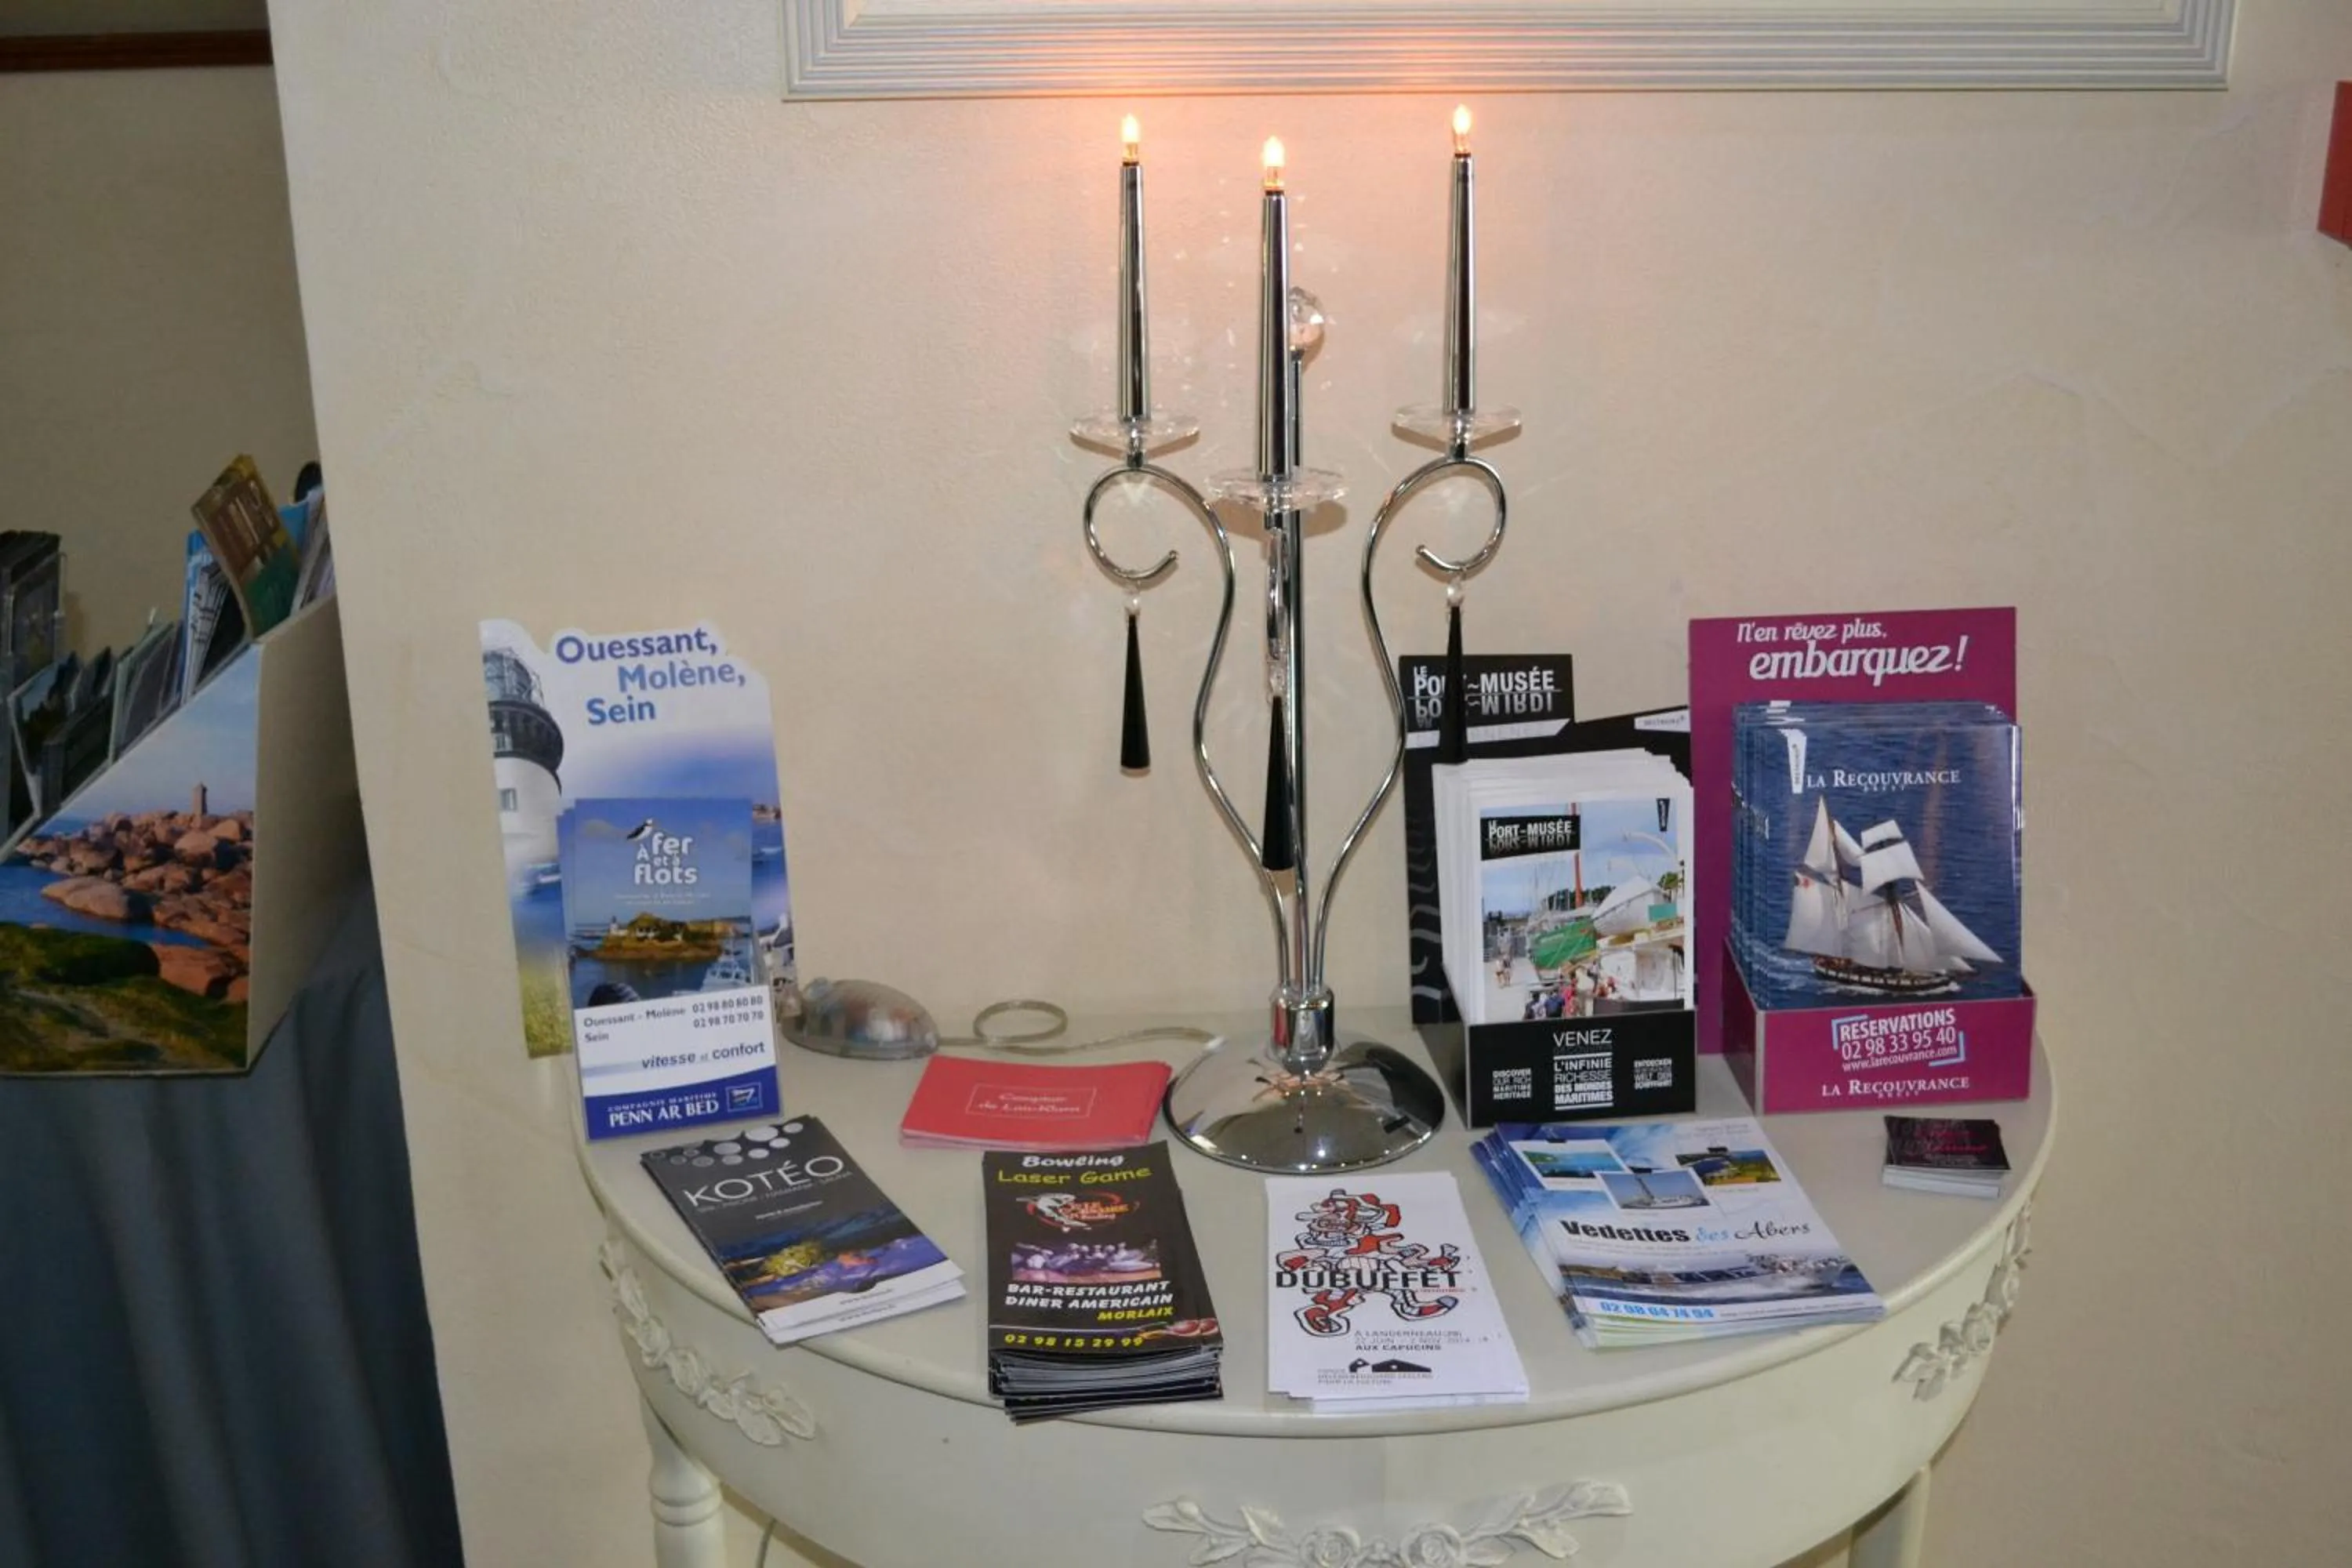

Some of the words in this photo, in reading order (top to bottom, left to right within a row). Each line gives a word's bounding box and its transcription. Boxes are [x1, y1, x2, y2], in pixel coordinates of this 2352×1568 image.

[1737, 623, 1778, 643] N'en
[1784, 620, 1838, 641] rêvez
[556, 627, 717, 663] Ouessant,
[619, 660, 745, 691] Molène,
[586, 696, 655, 725] Sein
[652, 832, 693, 855] fer
[634, 864, 698, 885] flots
[692, 1003, 705, 1014] 02
[708, 1000, 720, 1012] 98
[693, 1018, 706, 1029] 02
[1840, 1007, 1956, 1042] RESERVATIONS
[584, 1032, 609, 1043] Sein
[1553, 1029, 1612, 1047] VENEZ
[1842, 1040, 1861, 1060] 02
[1865, 1037, 1886, 1056] 98
[1889, 1034, 1907, 1052] 33
[1913, 1030, 1931, 1049] 95
[1936, 1026, 1956, 1044] 40
[641, 1053, 696, 1069] vitesse
[712, 1041, 765, 1060] confort
[1842, 1046, 1958, 1072] www.larecouvrance.com
[609, 1109, 653, 1127] PENN
[658, 1105, 682, 1120] AR
[685, 1100, 720, 1116] BED
[1022, 1154, 1124, 1167] Bowling
[684, 1156, 844, 1207] KOTÉO
[998, 1170, 1070, 1185] Laser
[1080, 1166, 1152, 1185] Game
[1561, 1220, 1690, 1243] Vedettes
[1007, 1280, 1171, 1297] BAR-RESTAURANT
[1276, 1269, 1461, 1288] DUBUFFET
[1004, 1296, 1066, 1308] DINER
[1069, 1294, 1174, 1308] AMERICAIN
[1098, 1306, 1174, 1321] MORLAIX
[1035, 1335, 1057, 1346] 98
[1065, 1336, 1085, 1348] 15
